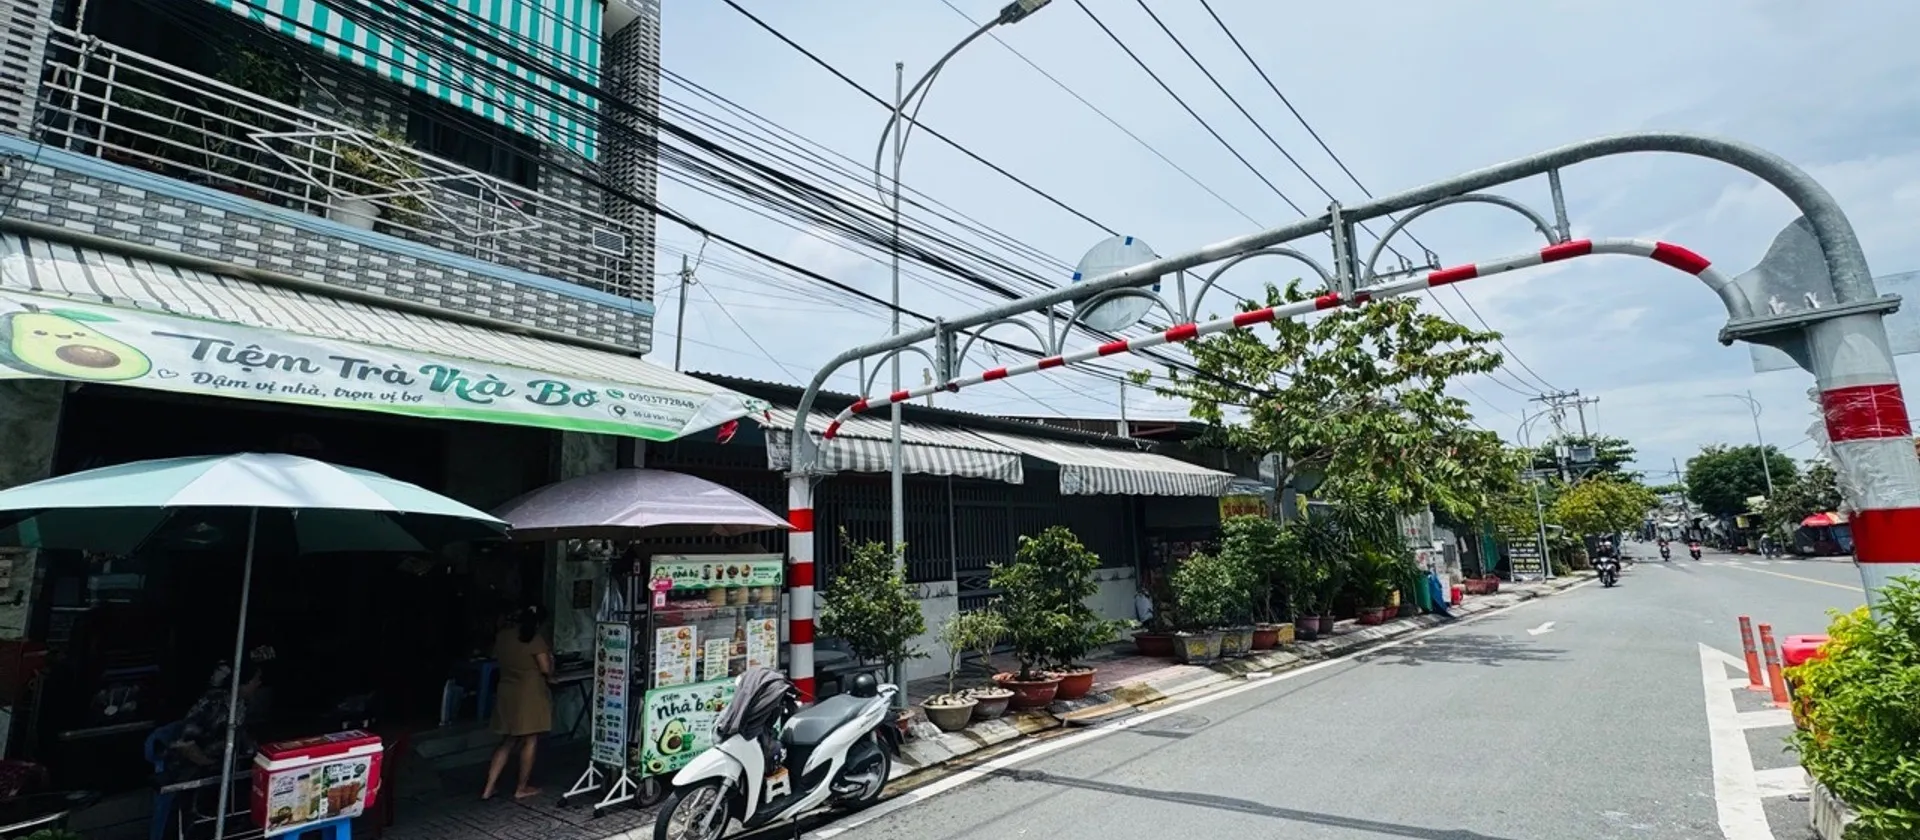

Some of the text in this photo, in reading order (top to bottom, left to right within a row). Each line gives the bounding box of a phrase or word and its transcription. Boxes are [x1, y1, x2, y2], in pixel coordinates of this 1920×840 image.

[151, 330, 601, 407] Tiệm Trà Nhà Bơ
[190, 371, 424, 403] Đậm vị nhà, trọn vị bơ
